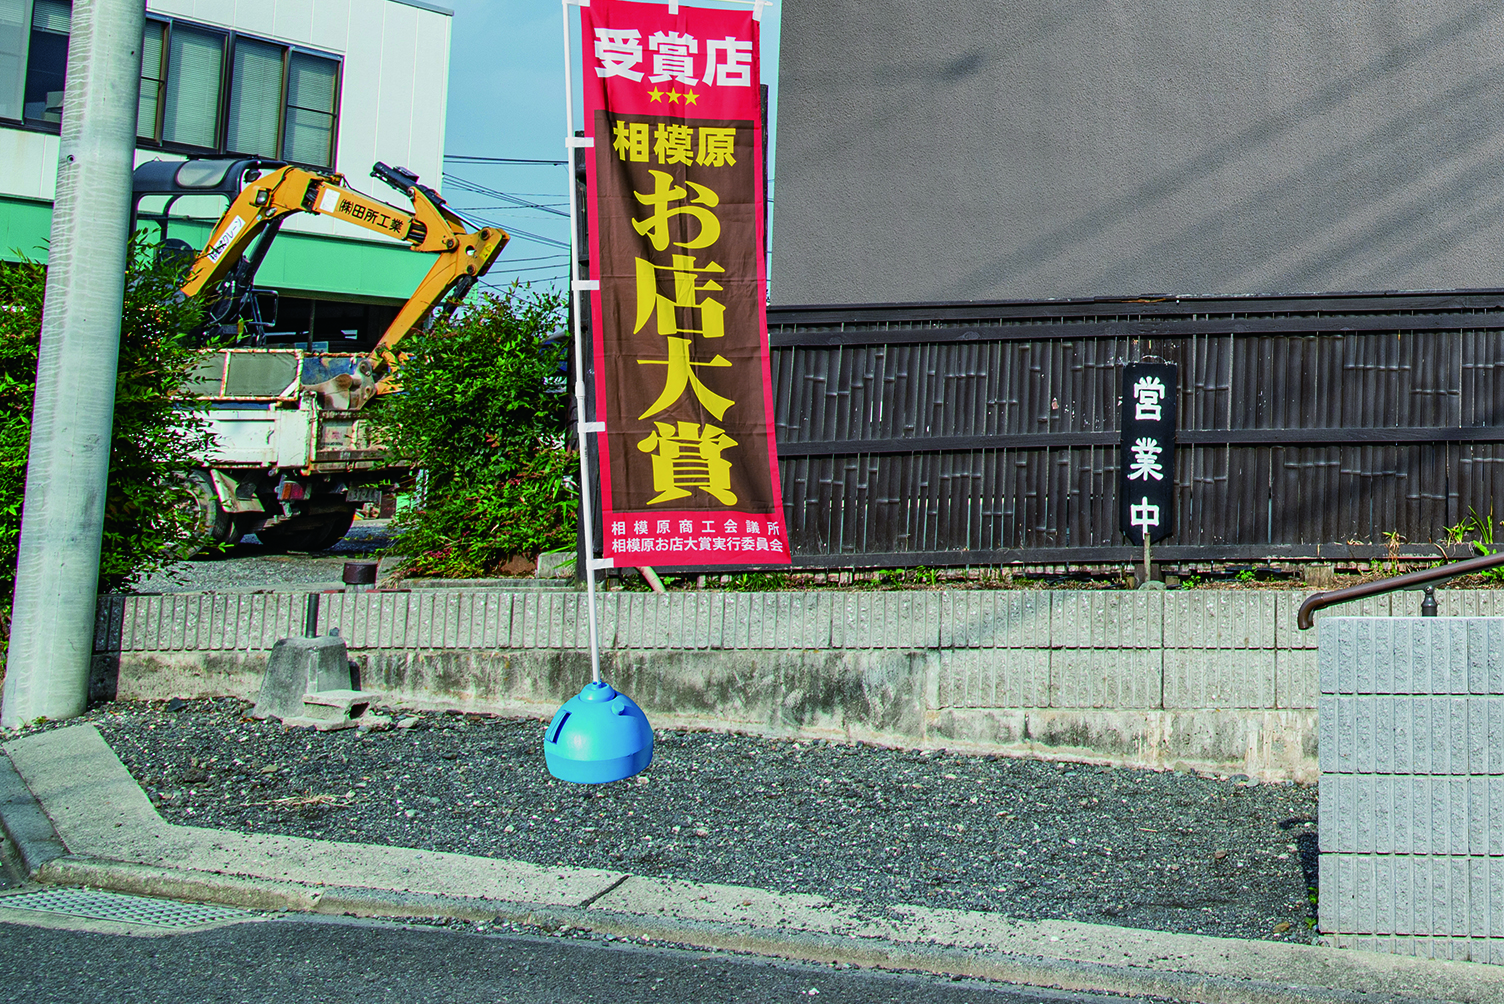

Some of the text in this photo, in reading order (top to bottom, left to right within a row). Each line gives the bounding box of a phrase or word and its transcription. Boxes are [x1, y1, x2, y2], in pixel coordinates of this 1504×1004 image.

[594, 27, 753, 87] 受賞店
[613, 120, 737, 167] 相模原
[631, 169, 739, 506] お店大賞
[1127, 376, 1165, 540] 営業中
[611, 519, 780, 536] 相模原商工会議所
[611, 536, 783, 553] 相模原お店大賞実行委員会
